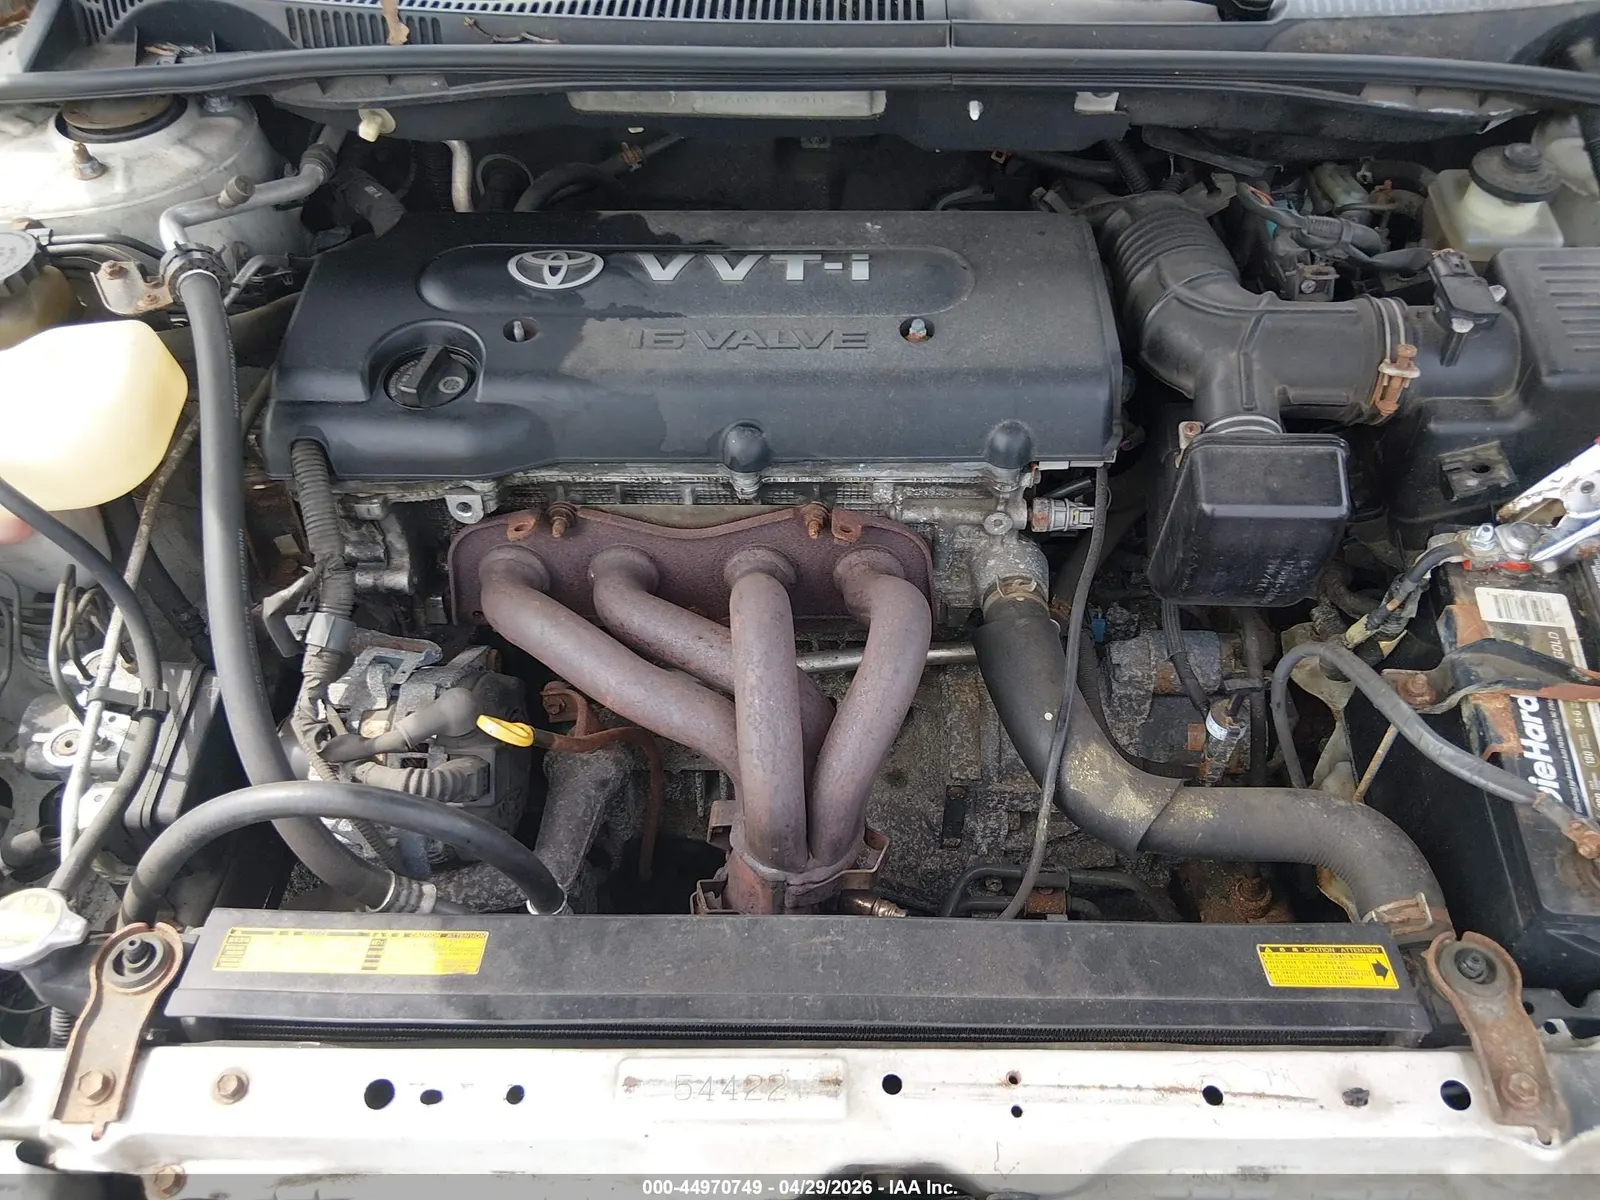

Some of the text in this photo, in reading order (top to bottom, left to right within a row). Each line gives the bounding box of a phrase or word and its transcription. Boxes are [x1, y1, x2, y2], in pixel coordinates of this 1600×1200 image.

[636, 253, 870, 282] VVT-i
[628, 328, 869, 350] 16 VALVE
[1548, 632, 1565, 659] GOLD
[1509, 694, 1564, 803] ieHard
